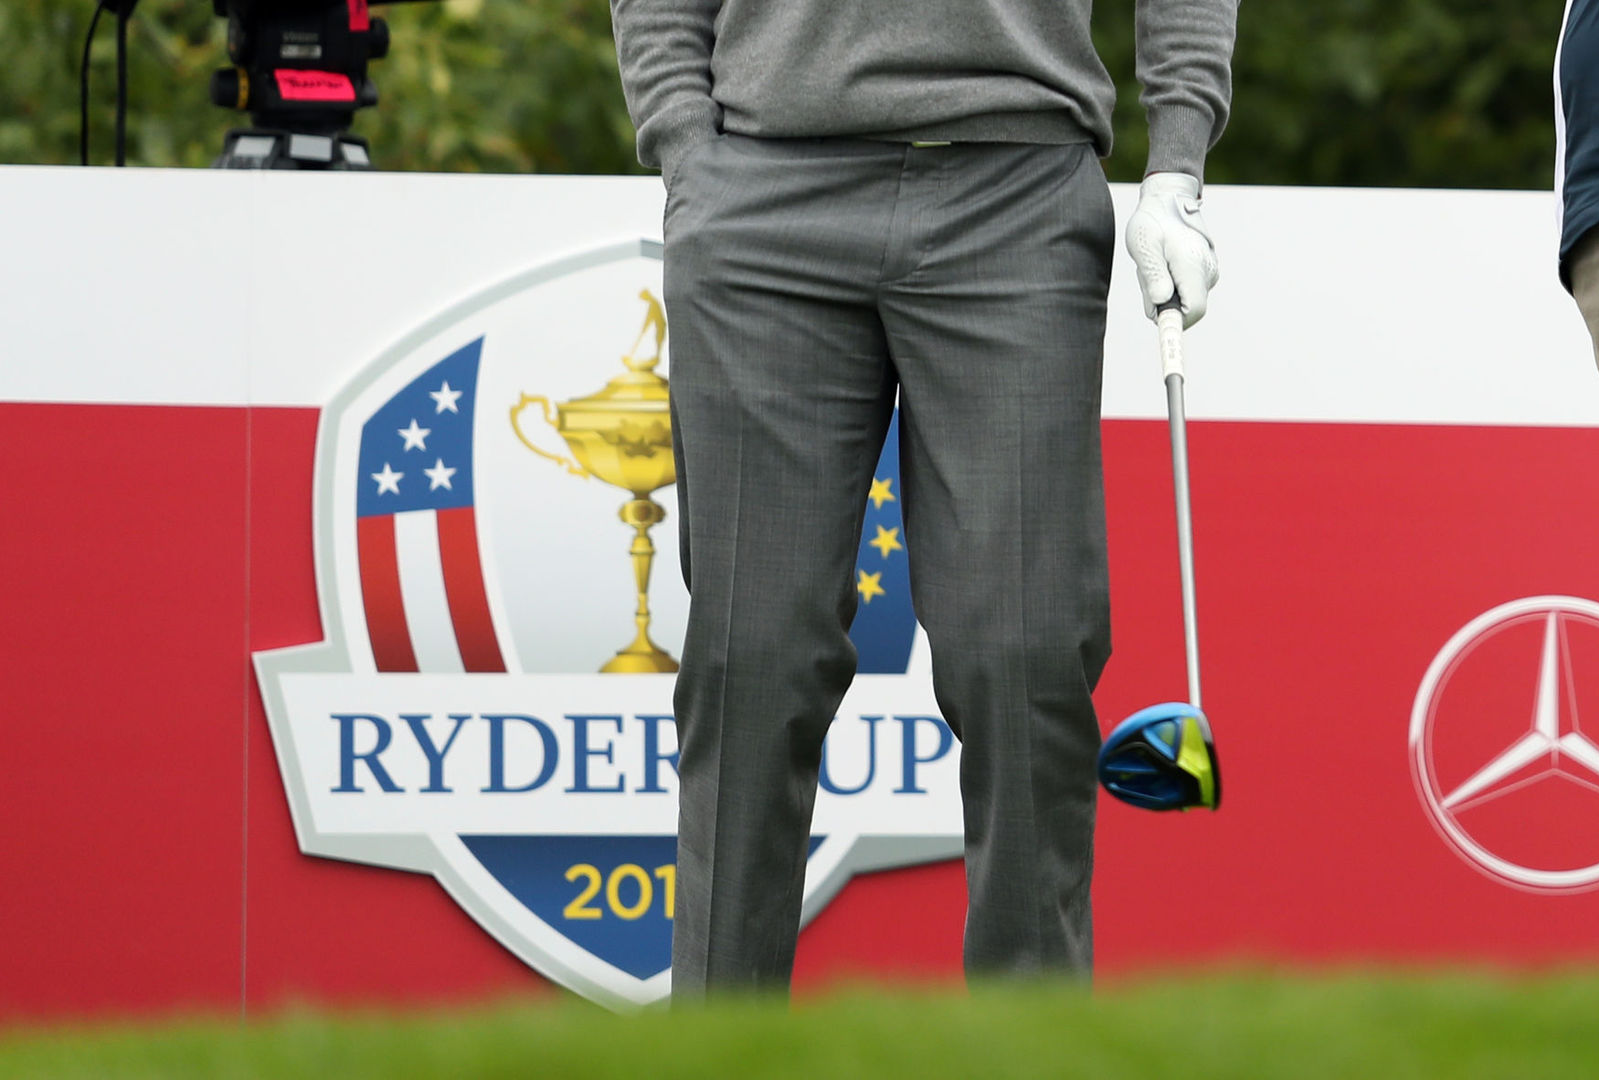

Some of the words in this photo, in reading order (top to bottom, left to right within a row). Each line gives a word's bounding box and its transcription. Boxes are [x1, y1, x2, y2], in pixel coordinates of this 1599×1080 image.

[329, 713, 680, 794] RYDER
[818, 715, 954, 796] UP
[563, 863, 676, 920] 201
